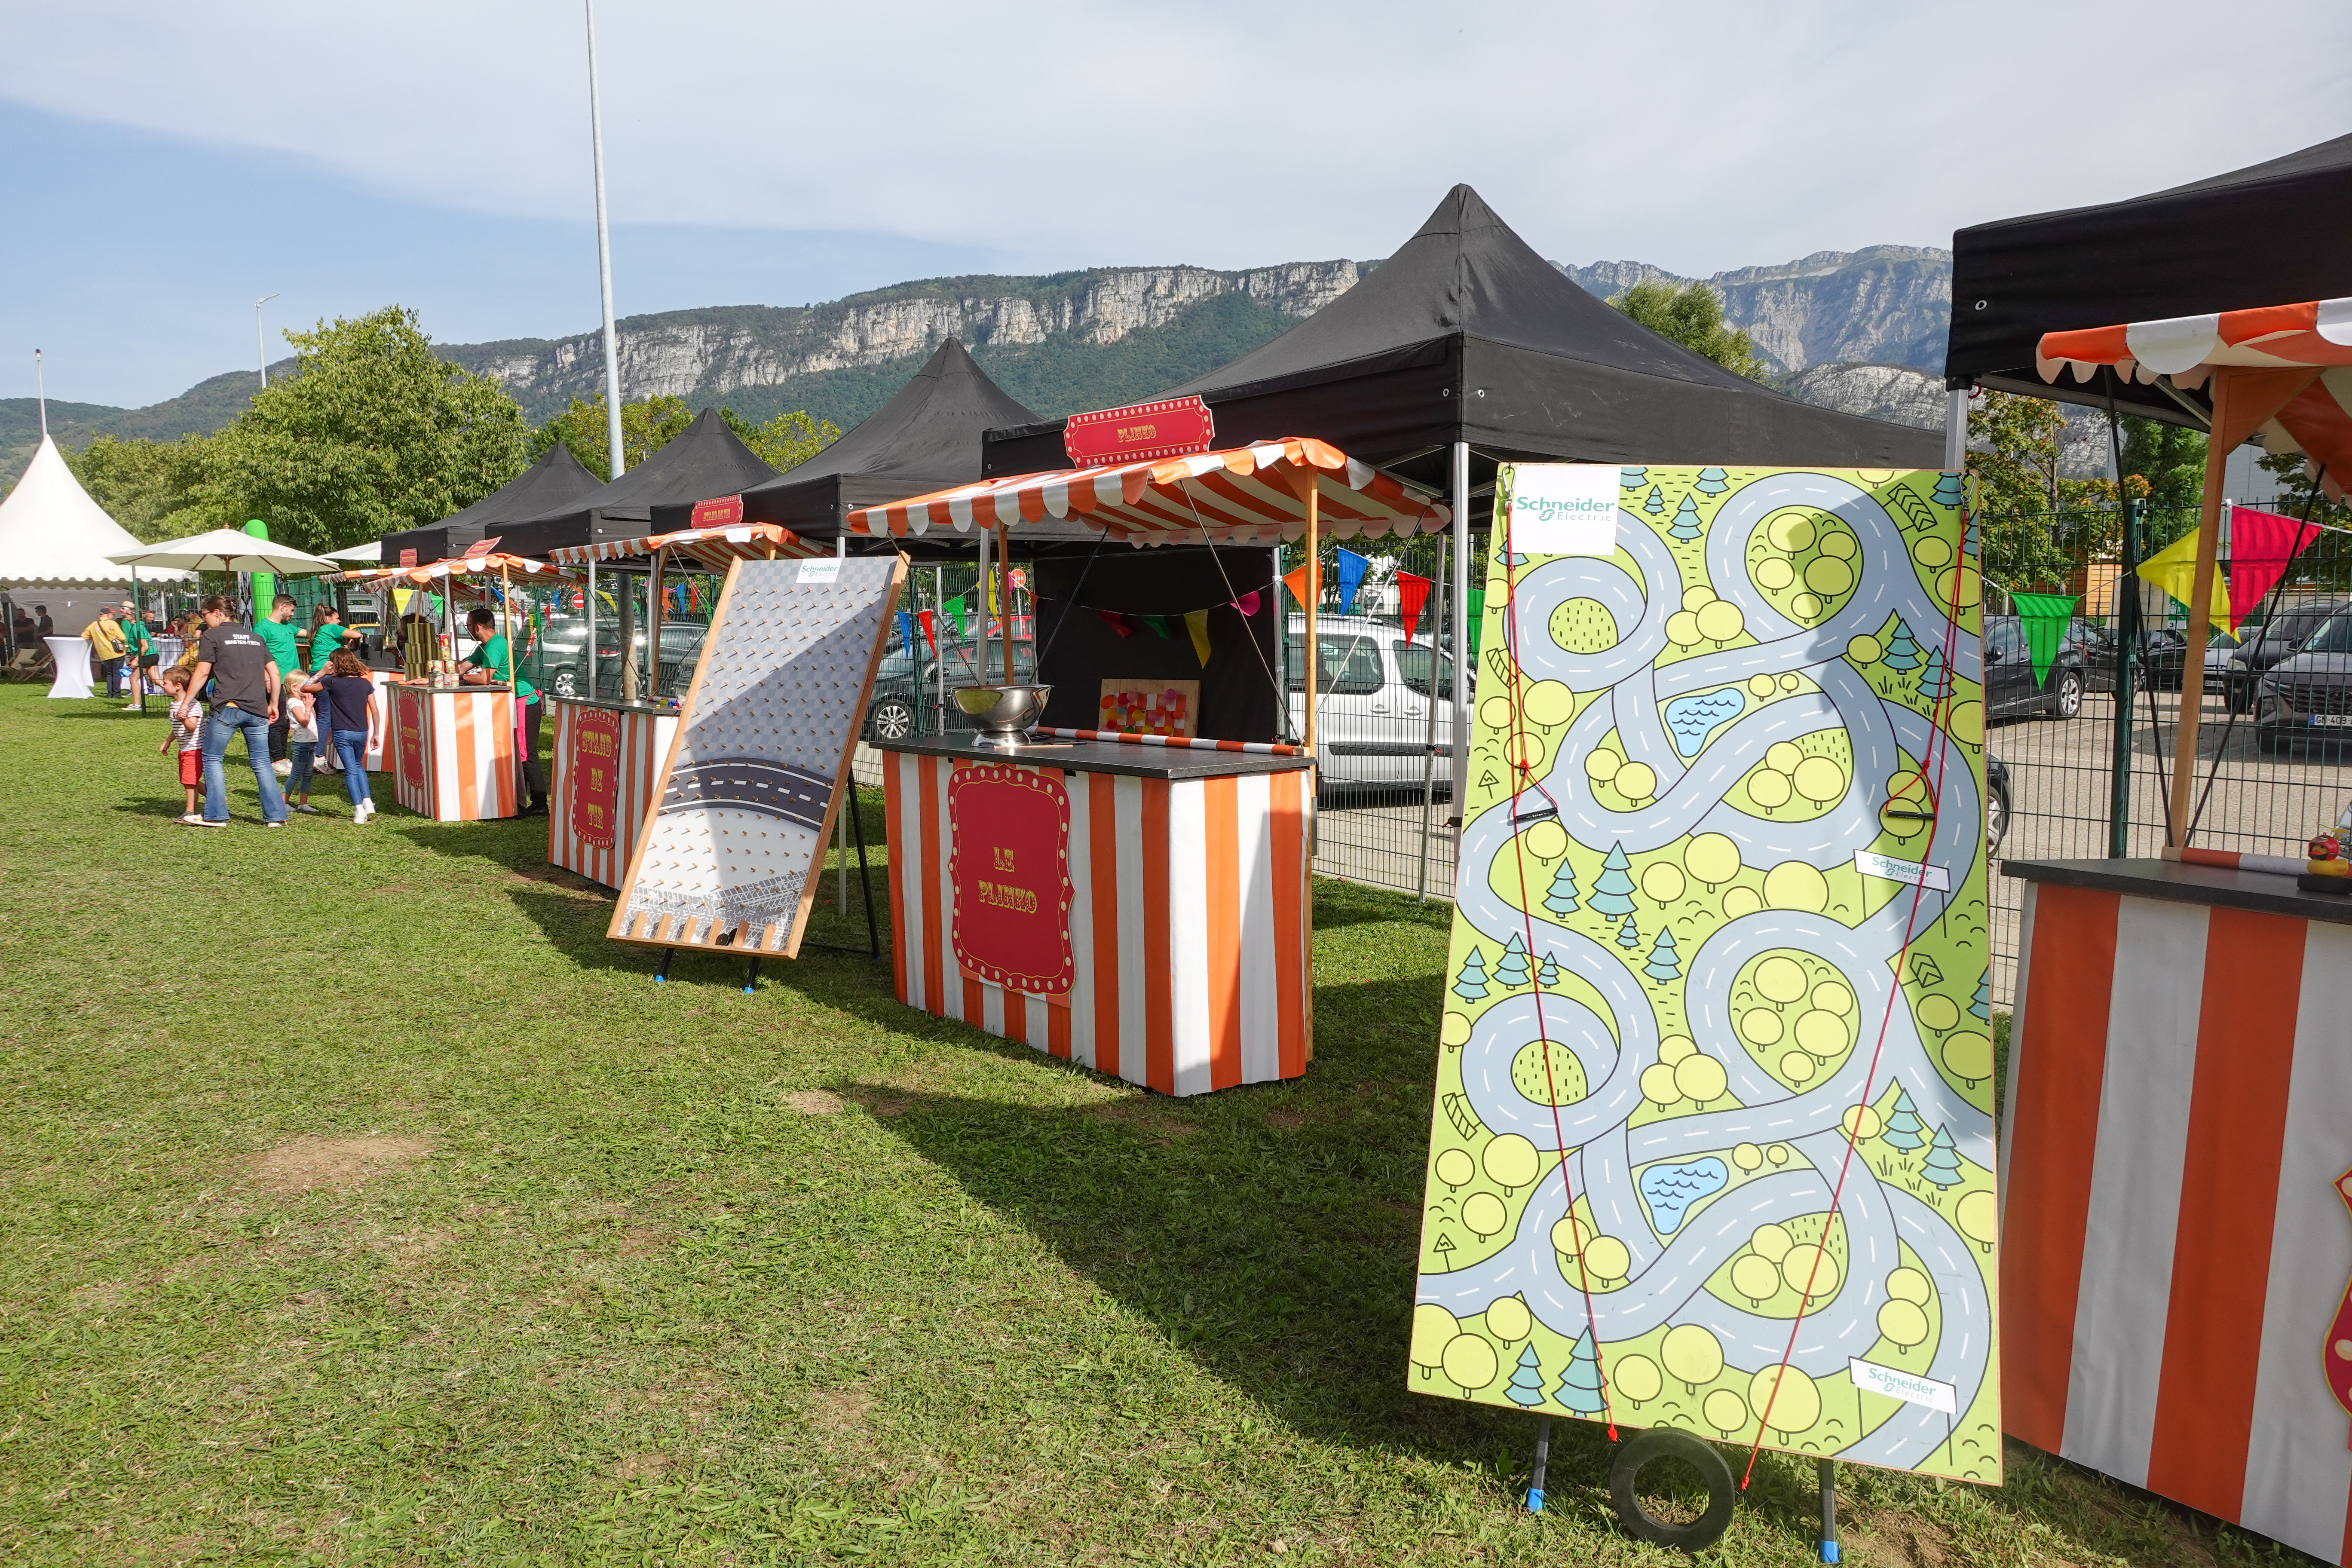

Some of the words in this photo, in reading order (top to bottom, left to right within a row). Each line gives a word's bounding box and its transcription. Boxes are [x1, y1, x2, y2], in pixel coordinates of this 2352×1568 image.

[1117, 424, 1156, 443] PLINKO
[1516, 496, 1615, 512] Schneider
[1557, 512, 1611, 521] Electric
[582, 730, 612, 758] STAND
[591, 767, 603, 792] DE
[588, 803, 603, 830] TIR
[993, 846, 1015, 873] LE
[1871, 857, 1932, 877] Schneider
[978, 880, 1037, 914] PLINKO
[1868, 1368, 1936, 1395] Schneider
[1896, 1387, 1933, 1403] Electric
